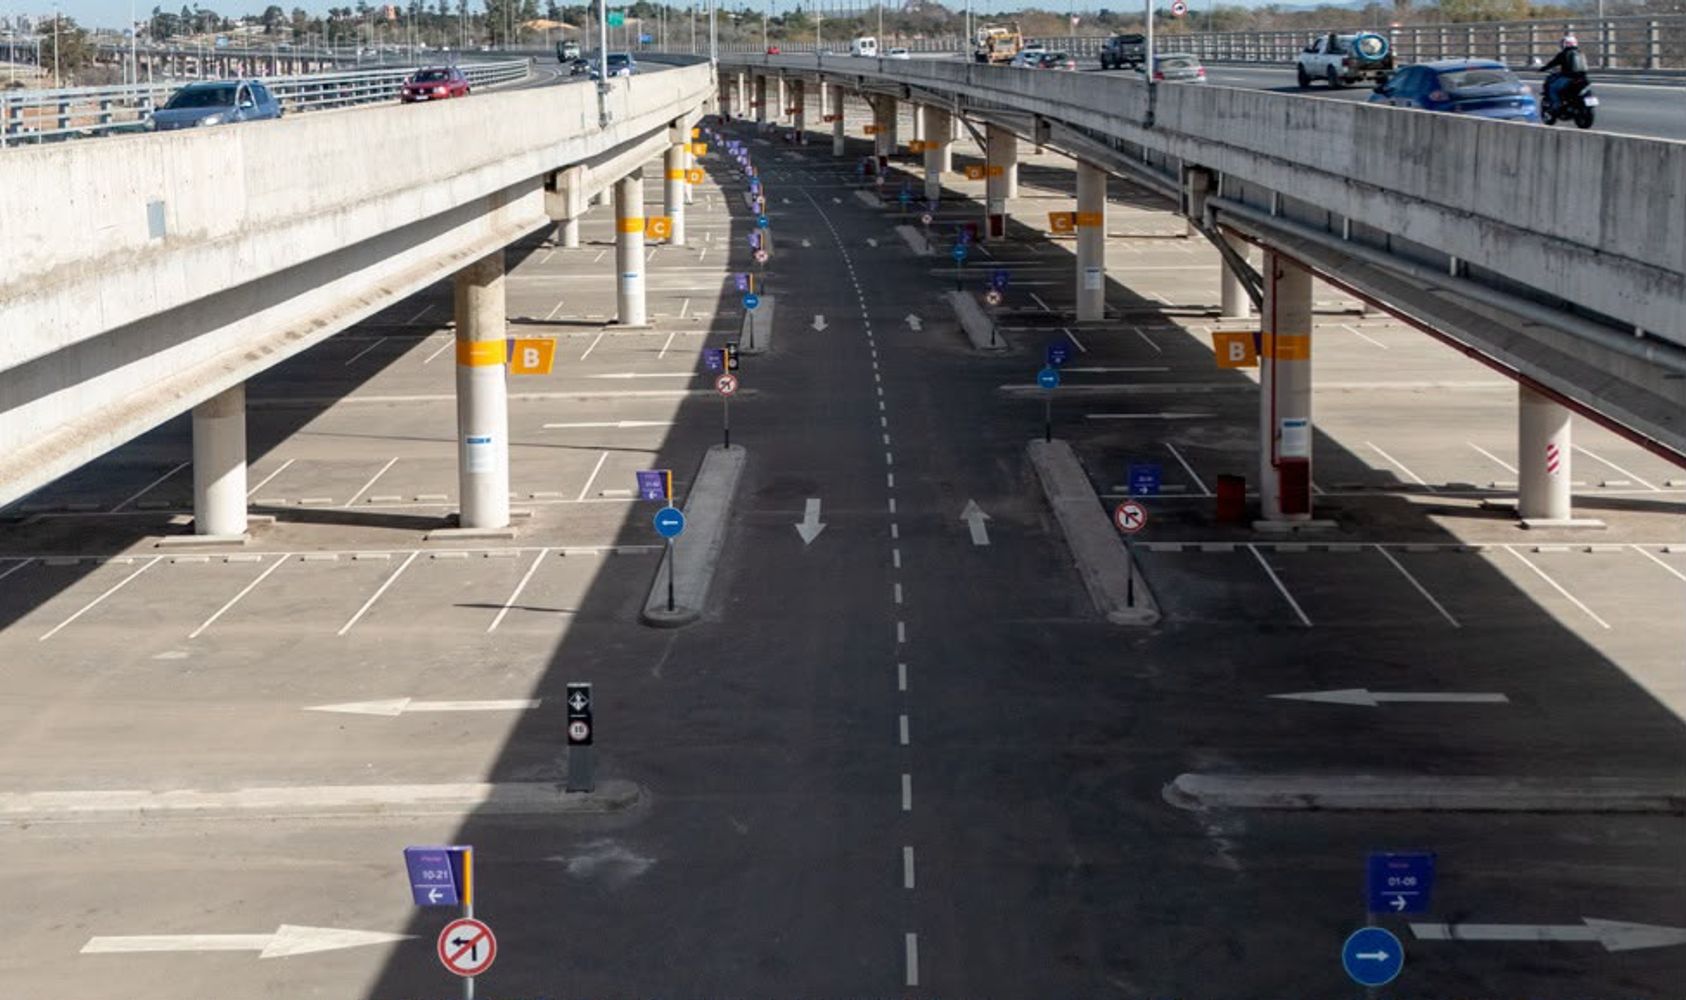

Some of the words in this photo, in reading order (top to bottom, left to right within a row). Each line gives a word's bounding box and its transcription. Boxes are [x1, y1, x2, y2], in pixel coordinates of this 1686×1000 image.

[655, 222, 665, 233] C
[1056, 218, 1066, 228] C
[523, 348, 540, 368] B
[1229, 342, 1246, 361] B
